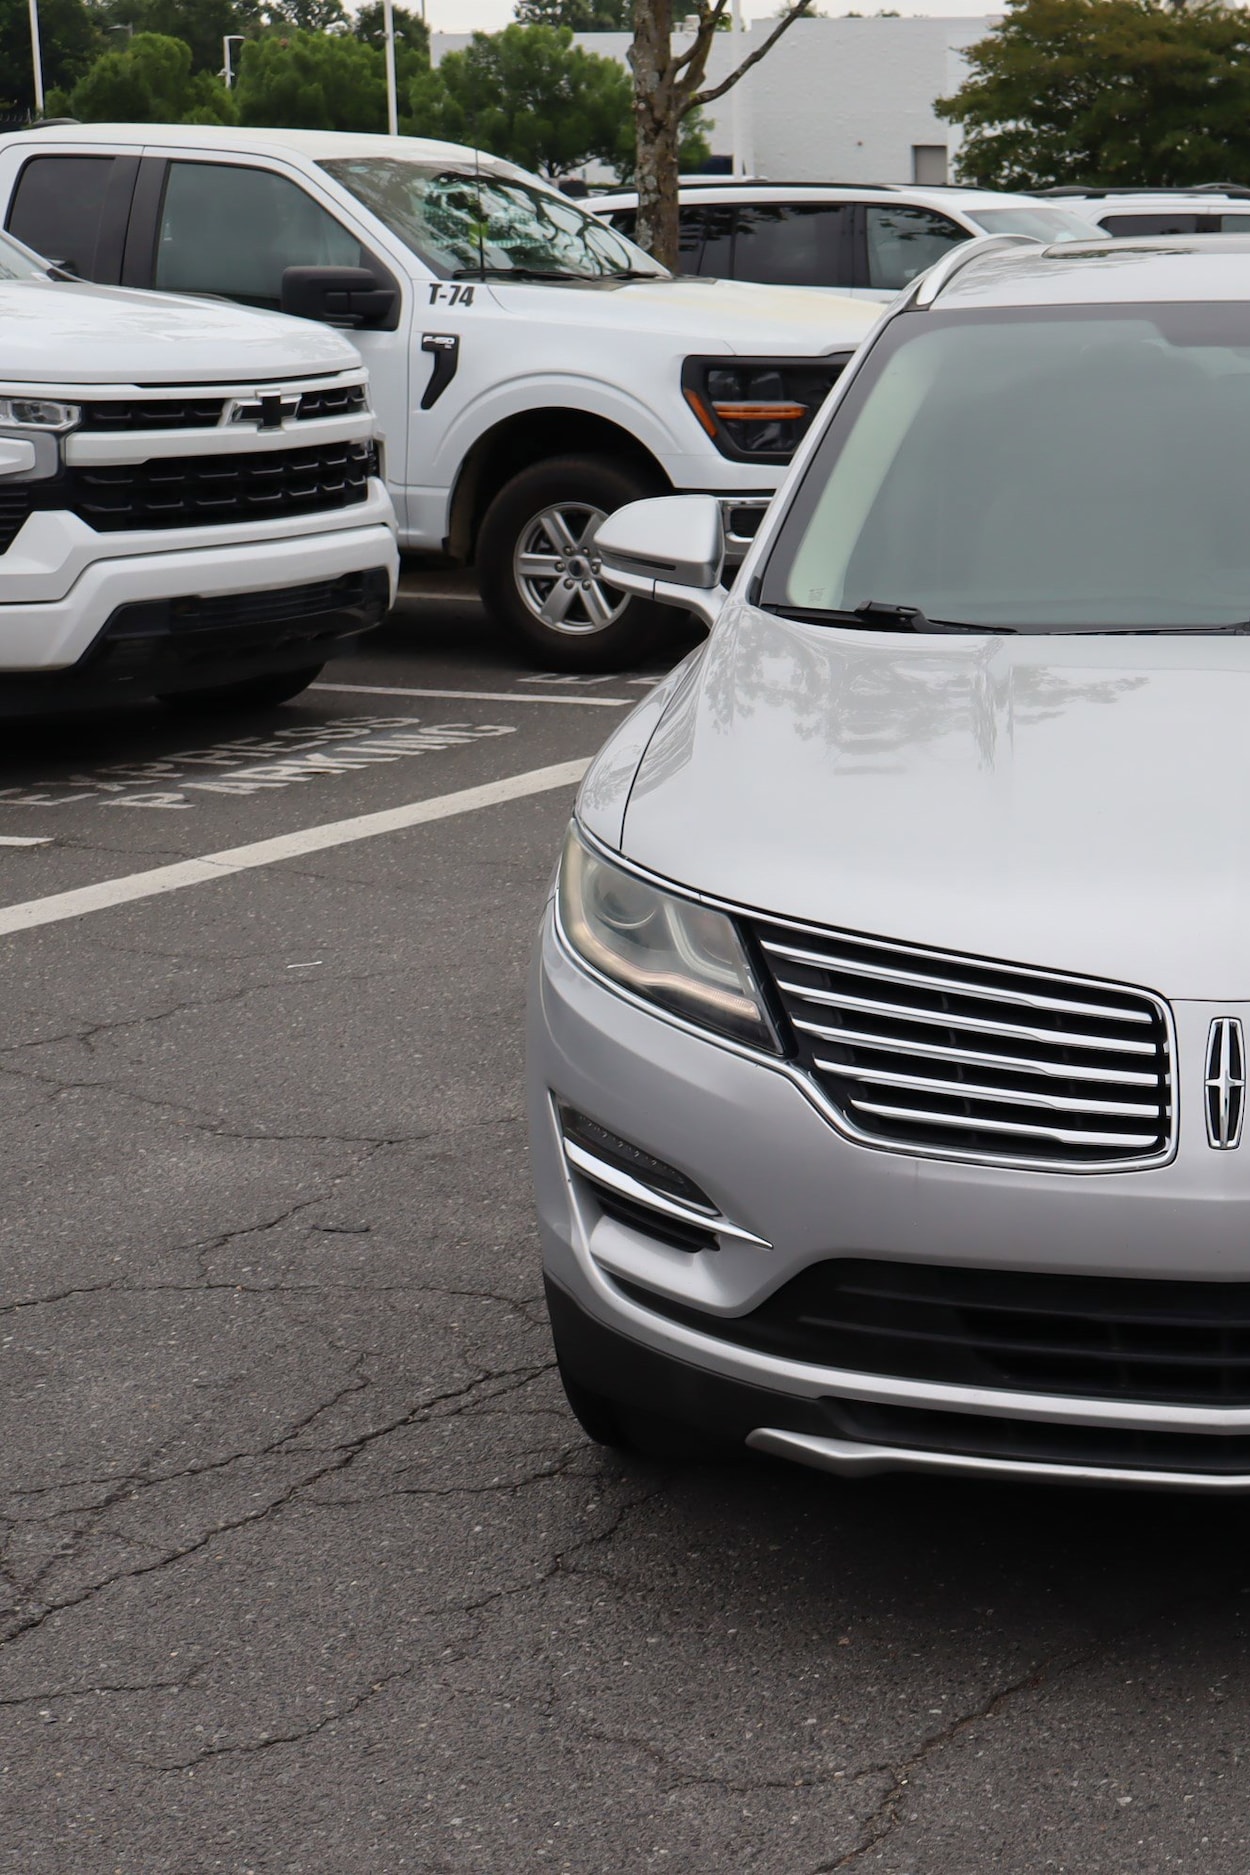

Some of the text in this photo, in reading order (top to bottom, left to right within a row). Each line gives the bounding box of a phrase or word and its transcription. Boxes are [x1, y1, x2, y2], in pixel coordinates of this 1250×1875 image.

[429, 283, 475, 307] T-74
[0, 716, 422, 806] EXPRESS
[97, 723, 518, 809] PARKING
